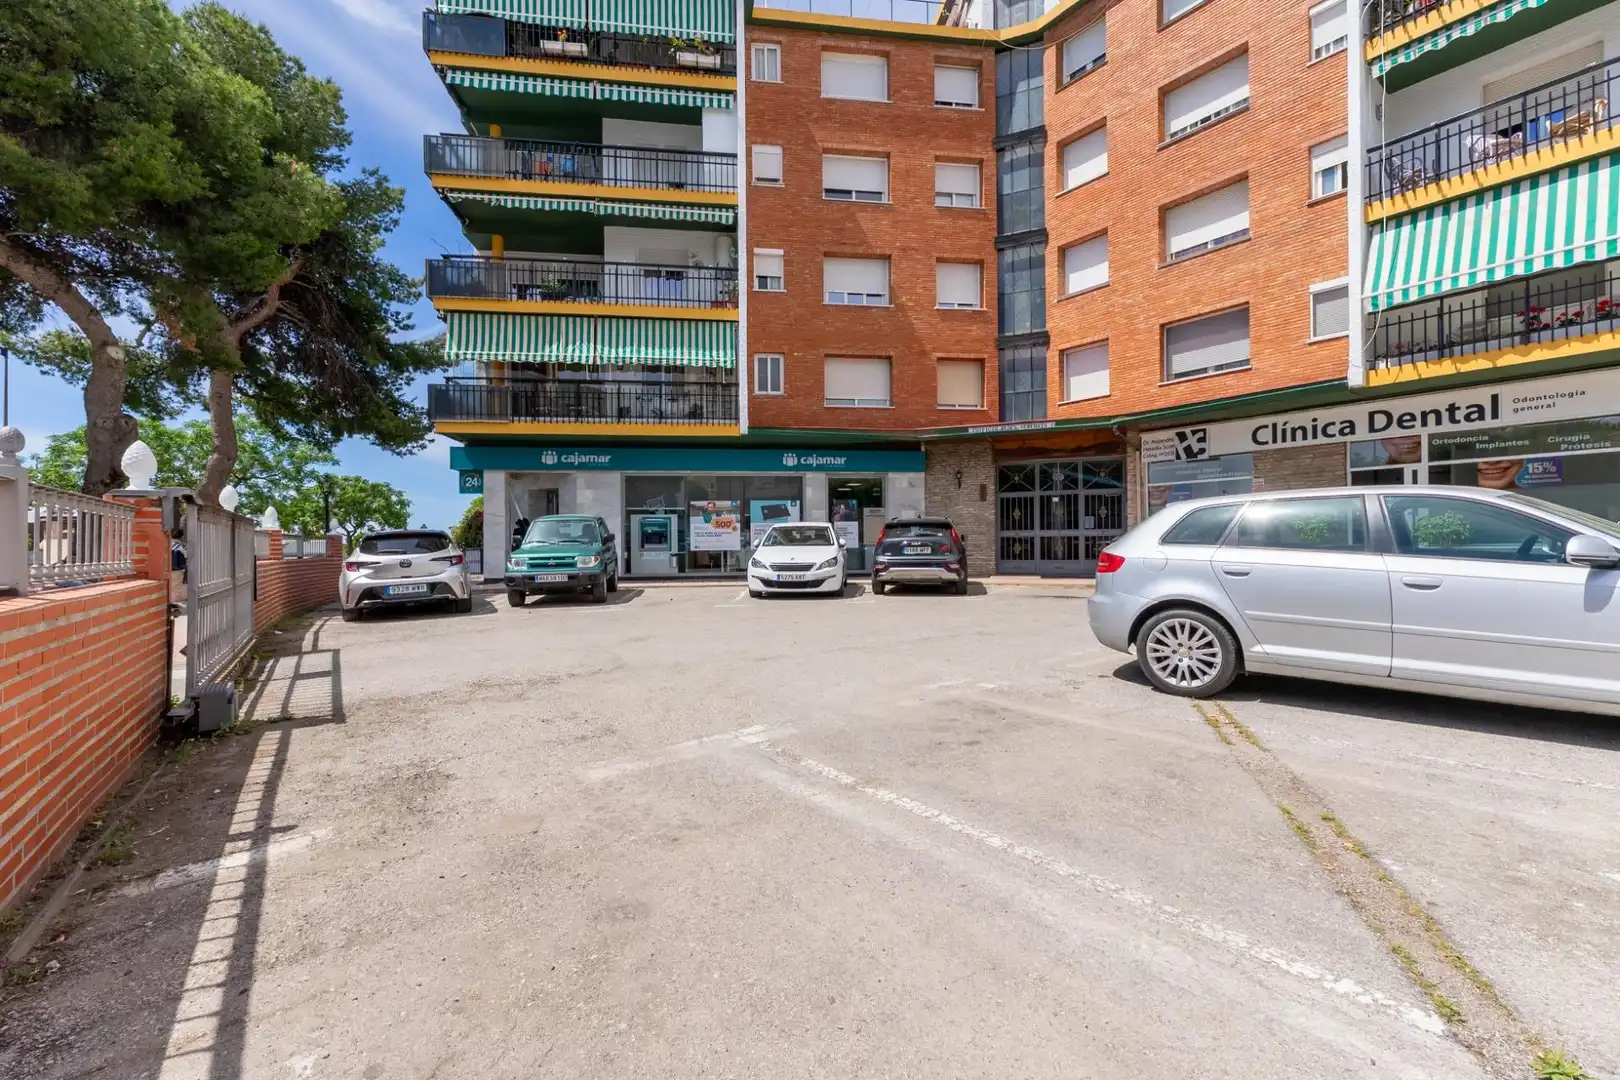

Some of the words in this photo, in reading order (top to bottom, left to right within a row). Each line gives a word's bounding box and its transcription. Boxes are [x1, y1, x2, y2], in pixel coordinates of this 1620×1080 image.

[1512, 389, 1586, 404] Odontología
[1512, 402, 1556, 414] general
[1251, 418, 1356, 446] Clínica
[1368, 393, 1500, 434] Dental
[1547, 432, 1590, 443] Cirugía
[1476, 439, 1530, 450] Implantes
[1560, 440, 1612, 450] Prótesis
[561, 452, 612, 466] cajamar
[800, 454, 847, 467] cajamar
[1527, 461, 1557, 474] 15%
